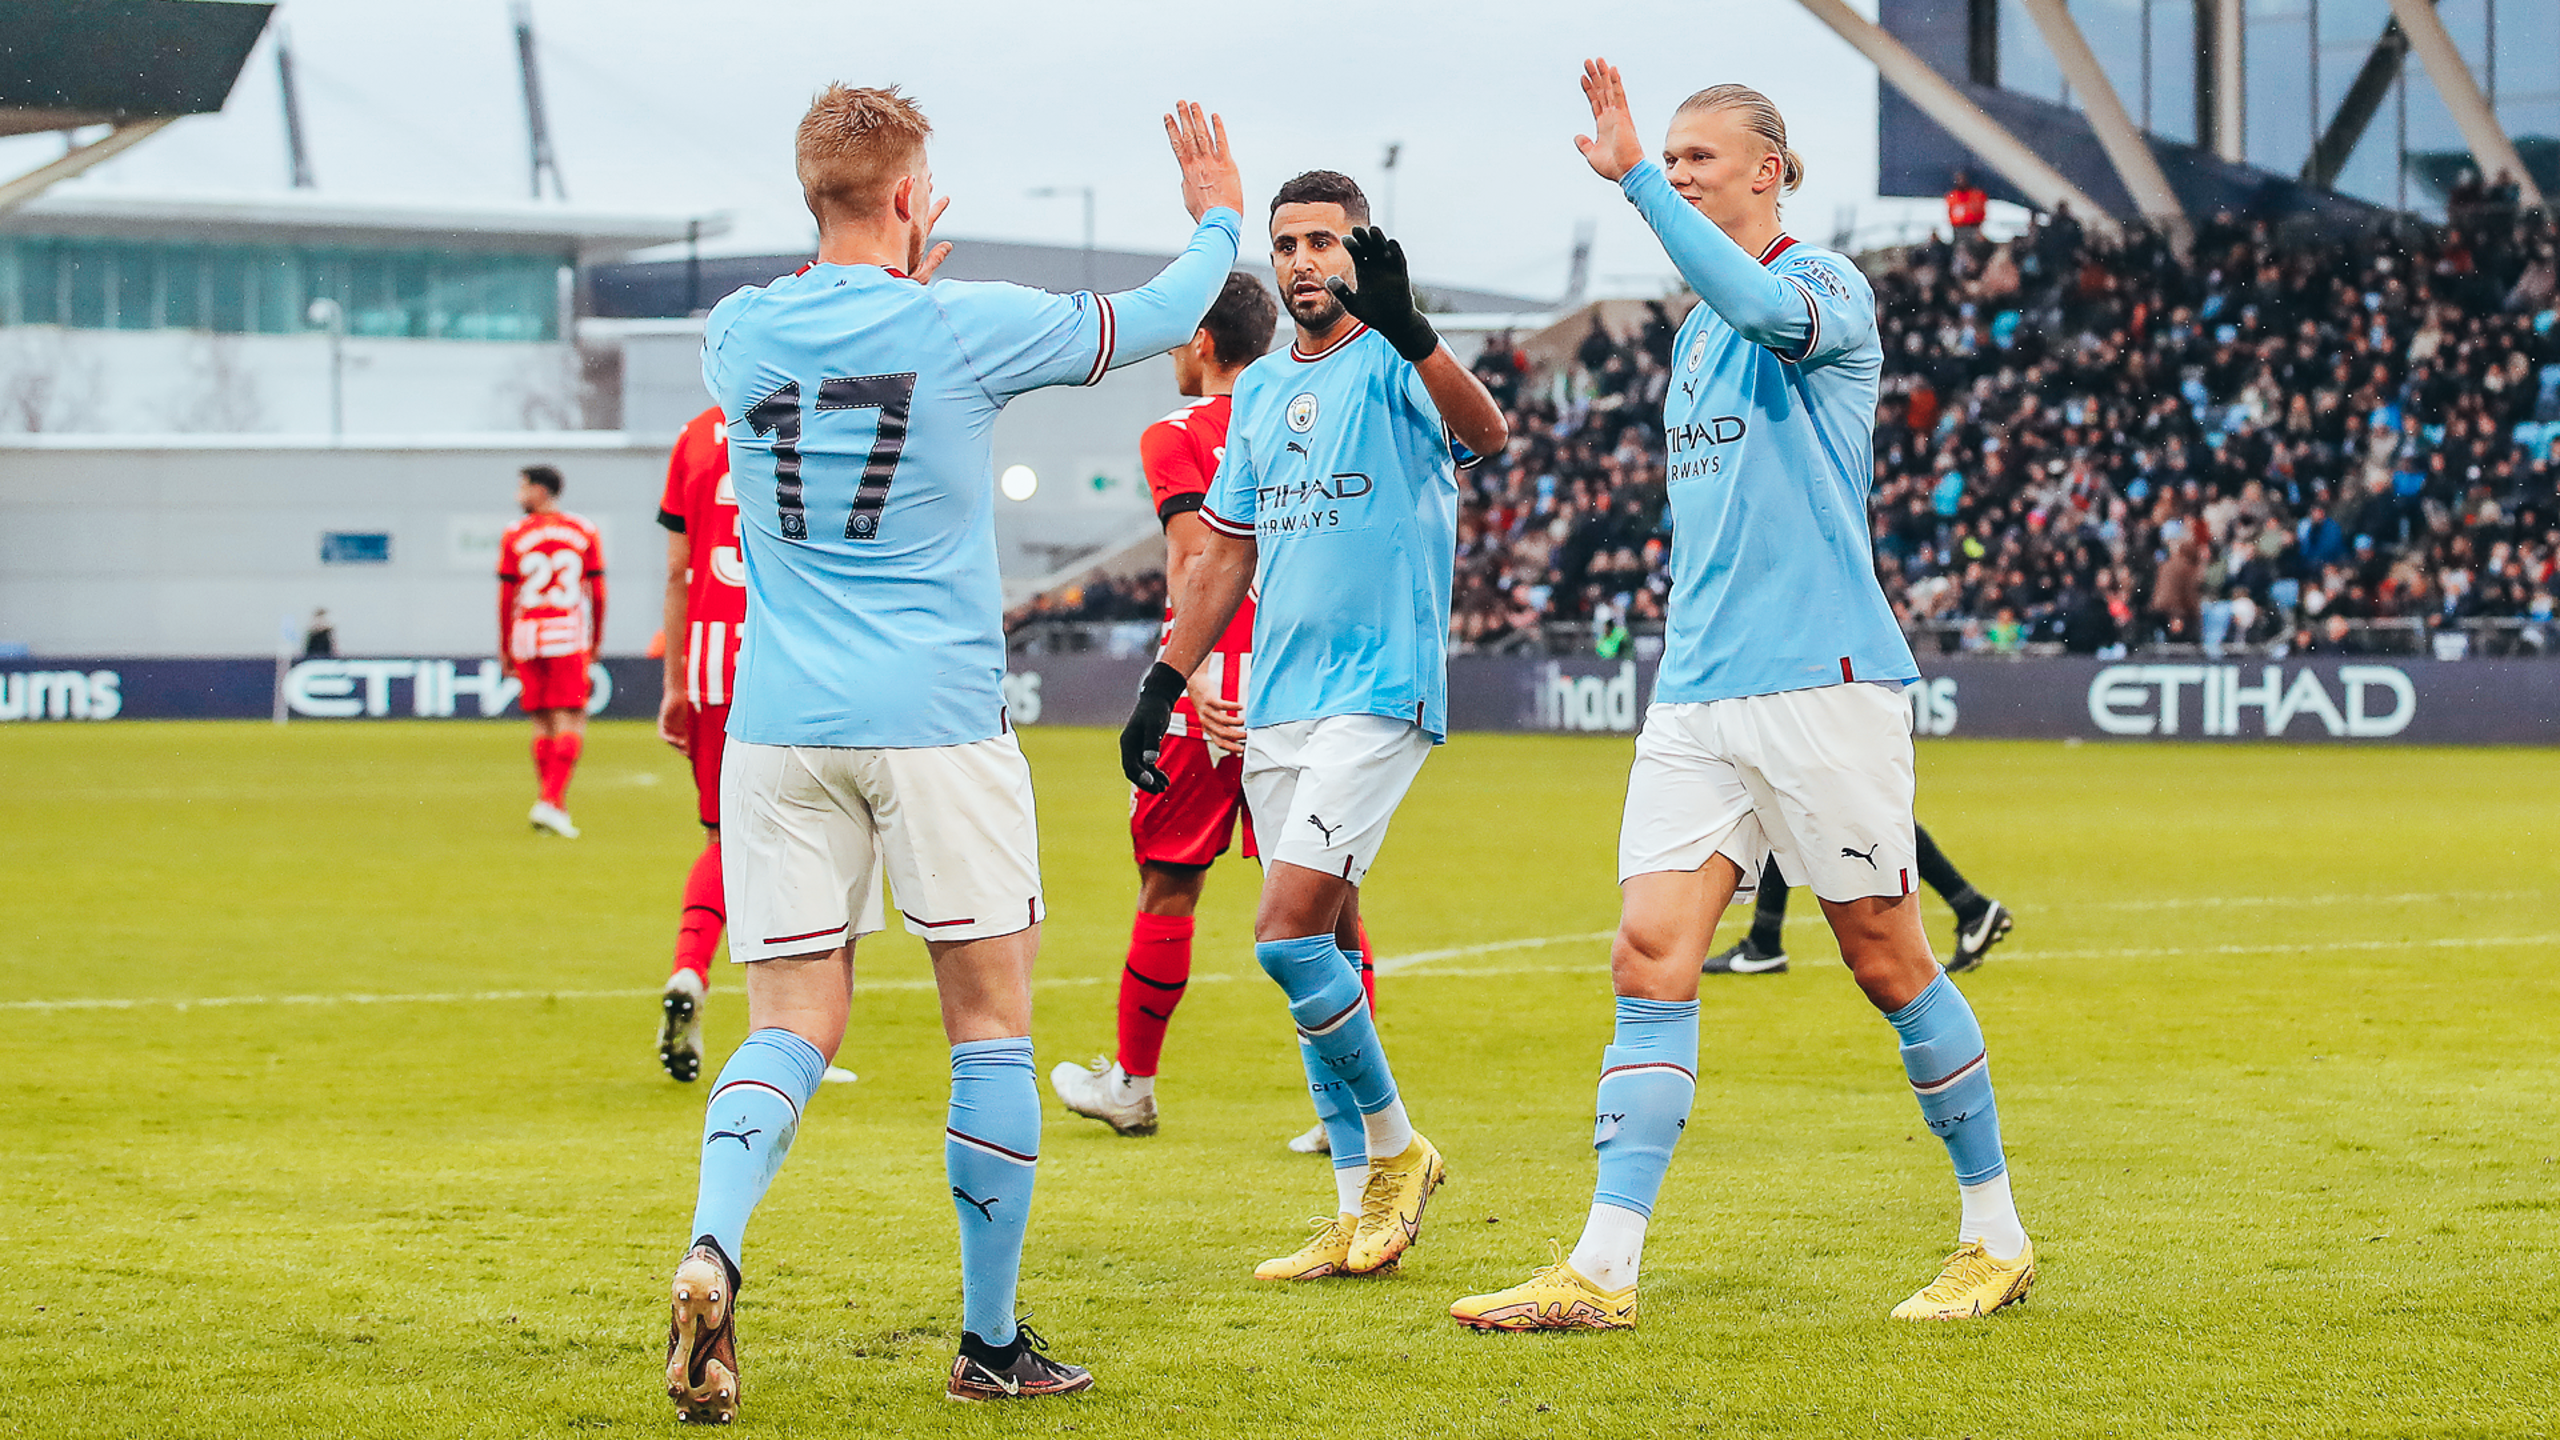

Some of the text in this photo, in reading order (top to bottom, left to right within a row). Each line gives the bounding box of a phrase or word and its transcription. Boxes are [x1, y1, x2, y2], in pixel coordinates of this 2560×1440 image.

[744, 372, 917, 540] 17
[1257, 472, 1373, 512] TIHAD
[1258, 509, 1340, 537] IRWAYS
[518, 549, 583, 609] 23
[2088, 664, 2417, 737] ETIHAD
[1312, 1080, 1343, 1093] CIT
[1595, 1113, 1625, 1125] ITY
